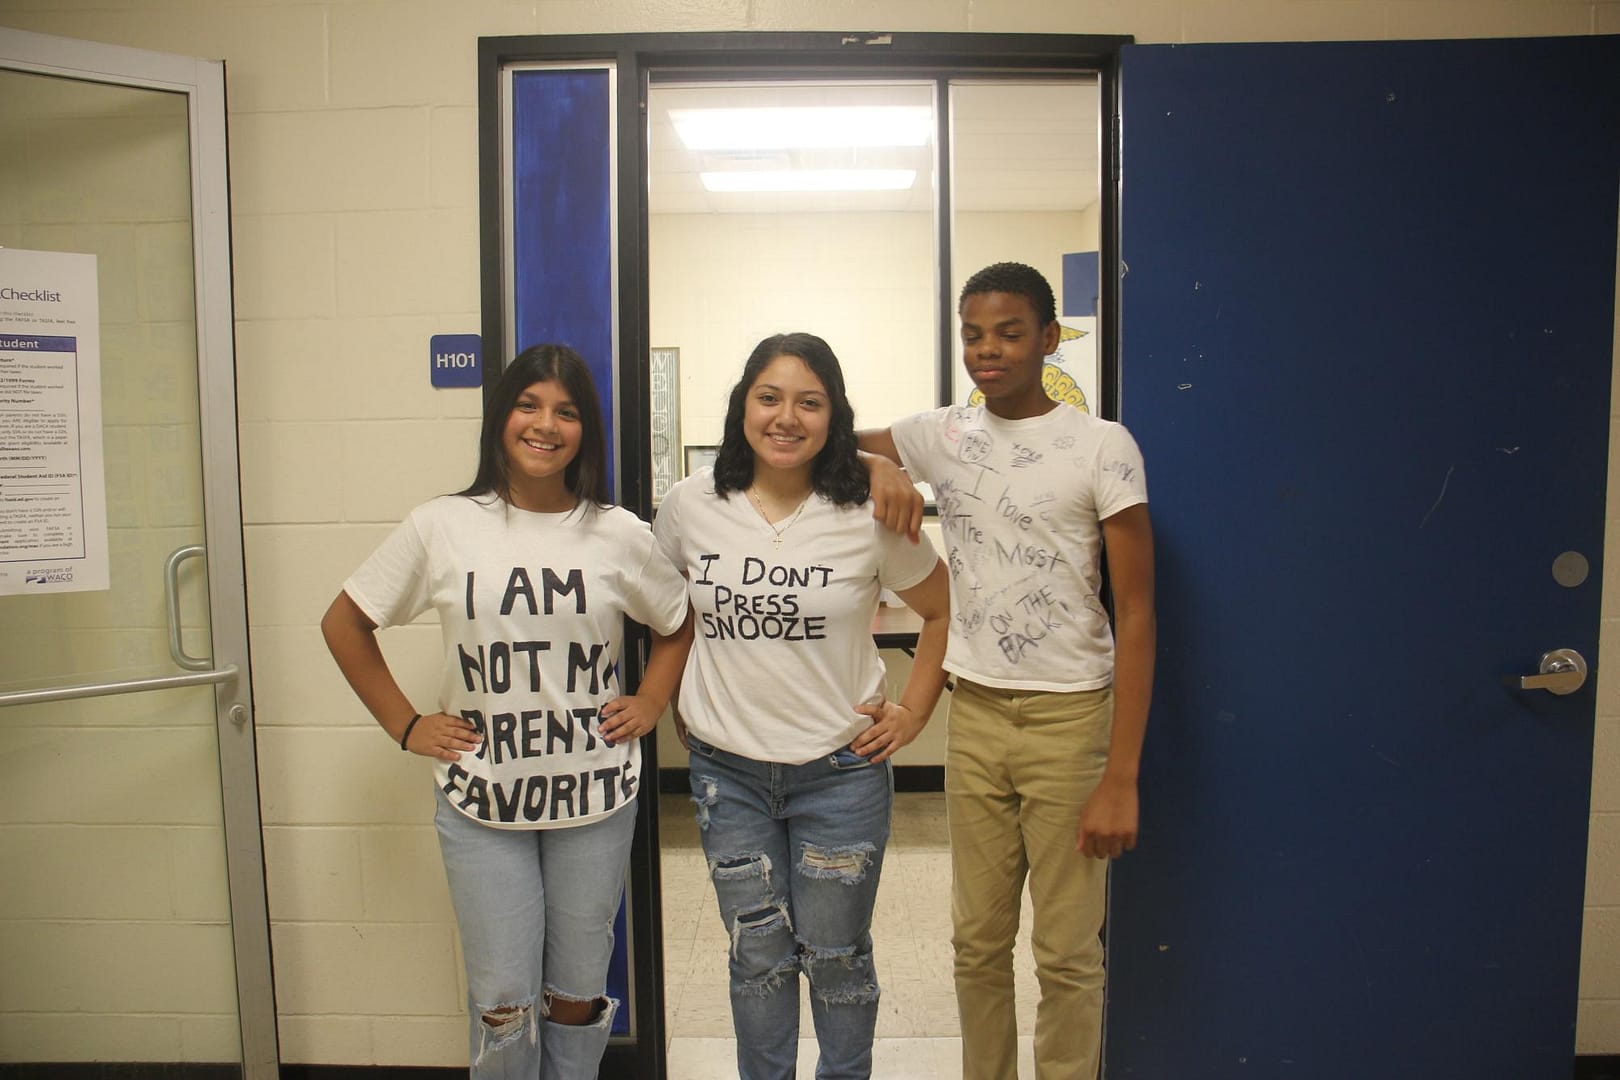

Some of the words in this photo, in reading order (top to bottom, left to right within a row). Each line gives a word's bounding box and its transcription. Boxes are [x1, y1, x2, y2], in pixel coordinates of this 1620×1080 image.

[1, 288, 62, 303] Checklist
[436, 352, 475, 368] H101
[996, 485, 1033, 531] have
[953, 515, 984, 544] The
[47, 573, 73, 581] WACO
[695, 553, 720, 586] I
[742, 557, 834, 588] DON'T
[466, 571, 476, 620] I
[500, 567, 586, 616] AM
[715, 585, 799, 617] PRESS
[1015, 584, 1057, 616] THE
[702, 612, 827, 642] SNOOZE
[458, 641, 551, 694] NOT
[443, 760, 638, 823] FAVORITE
